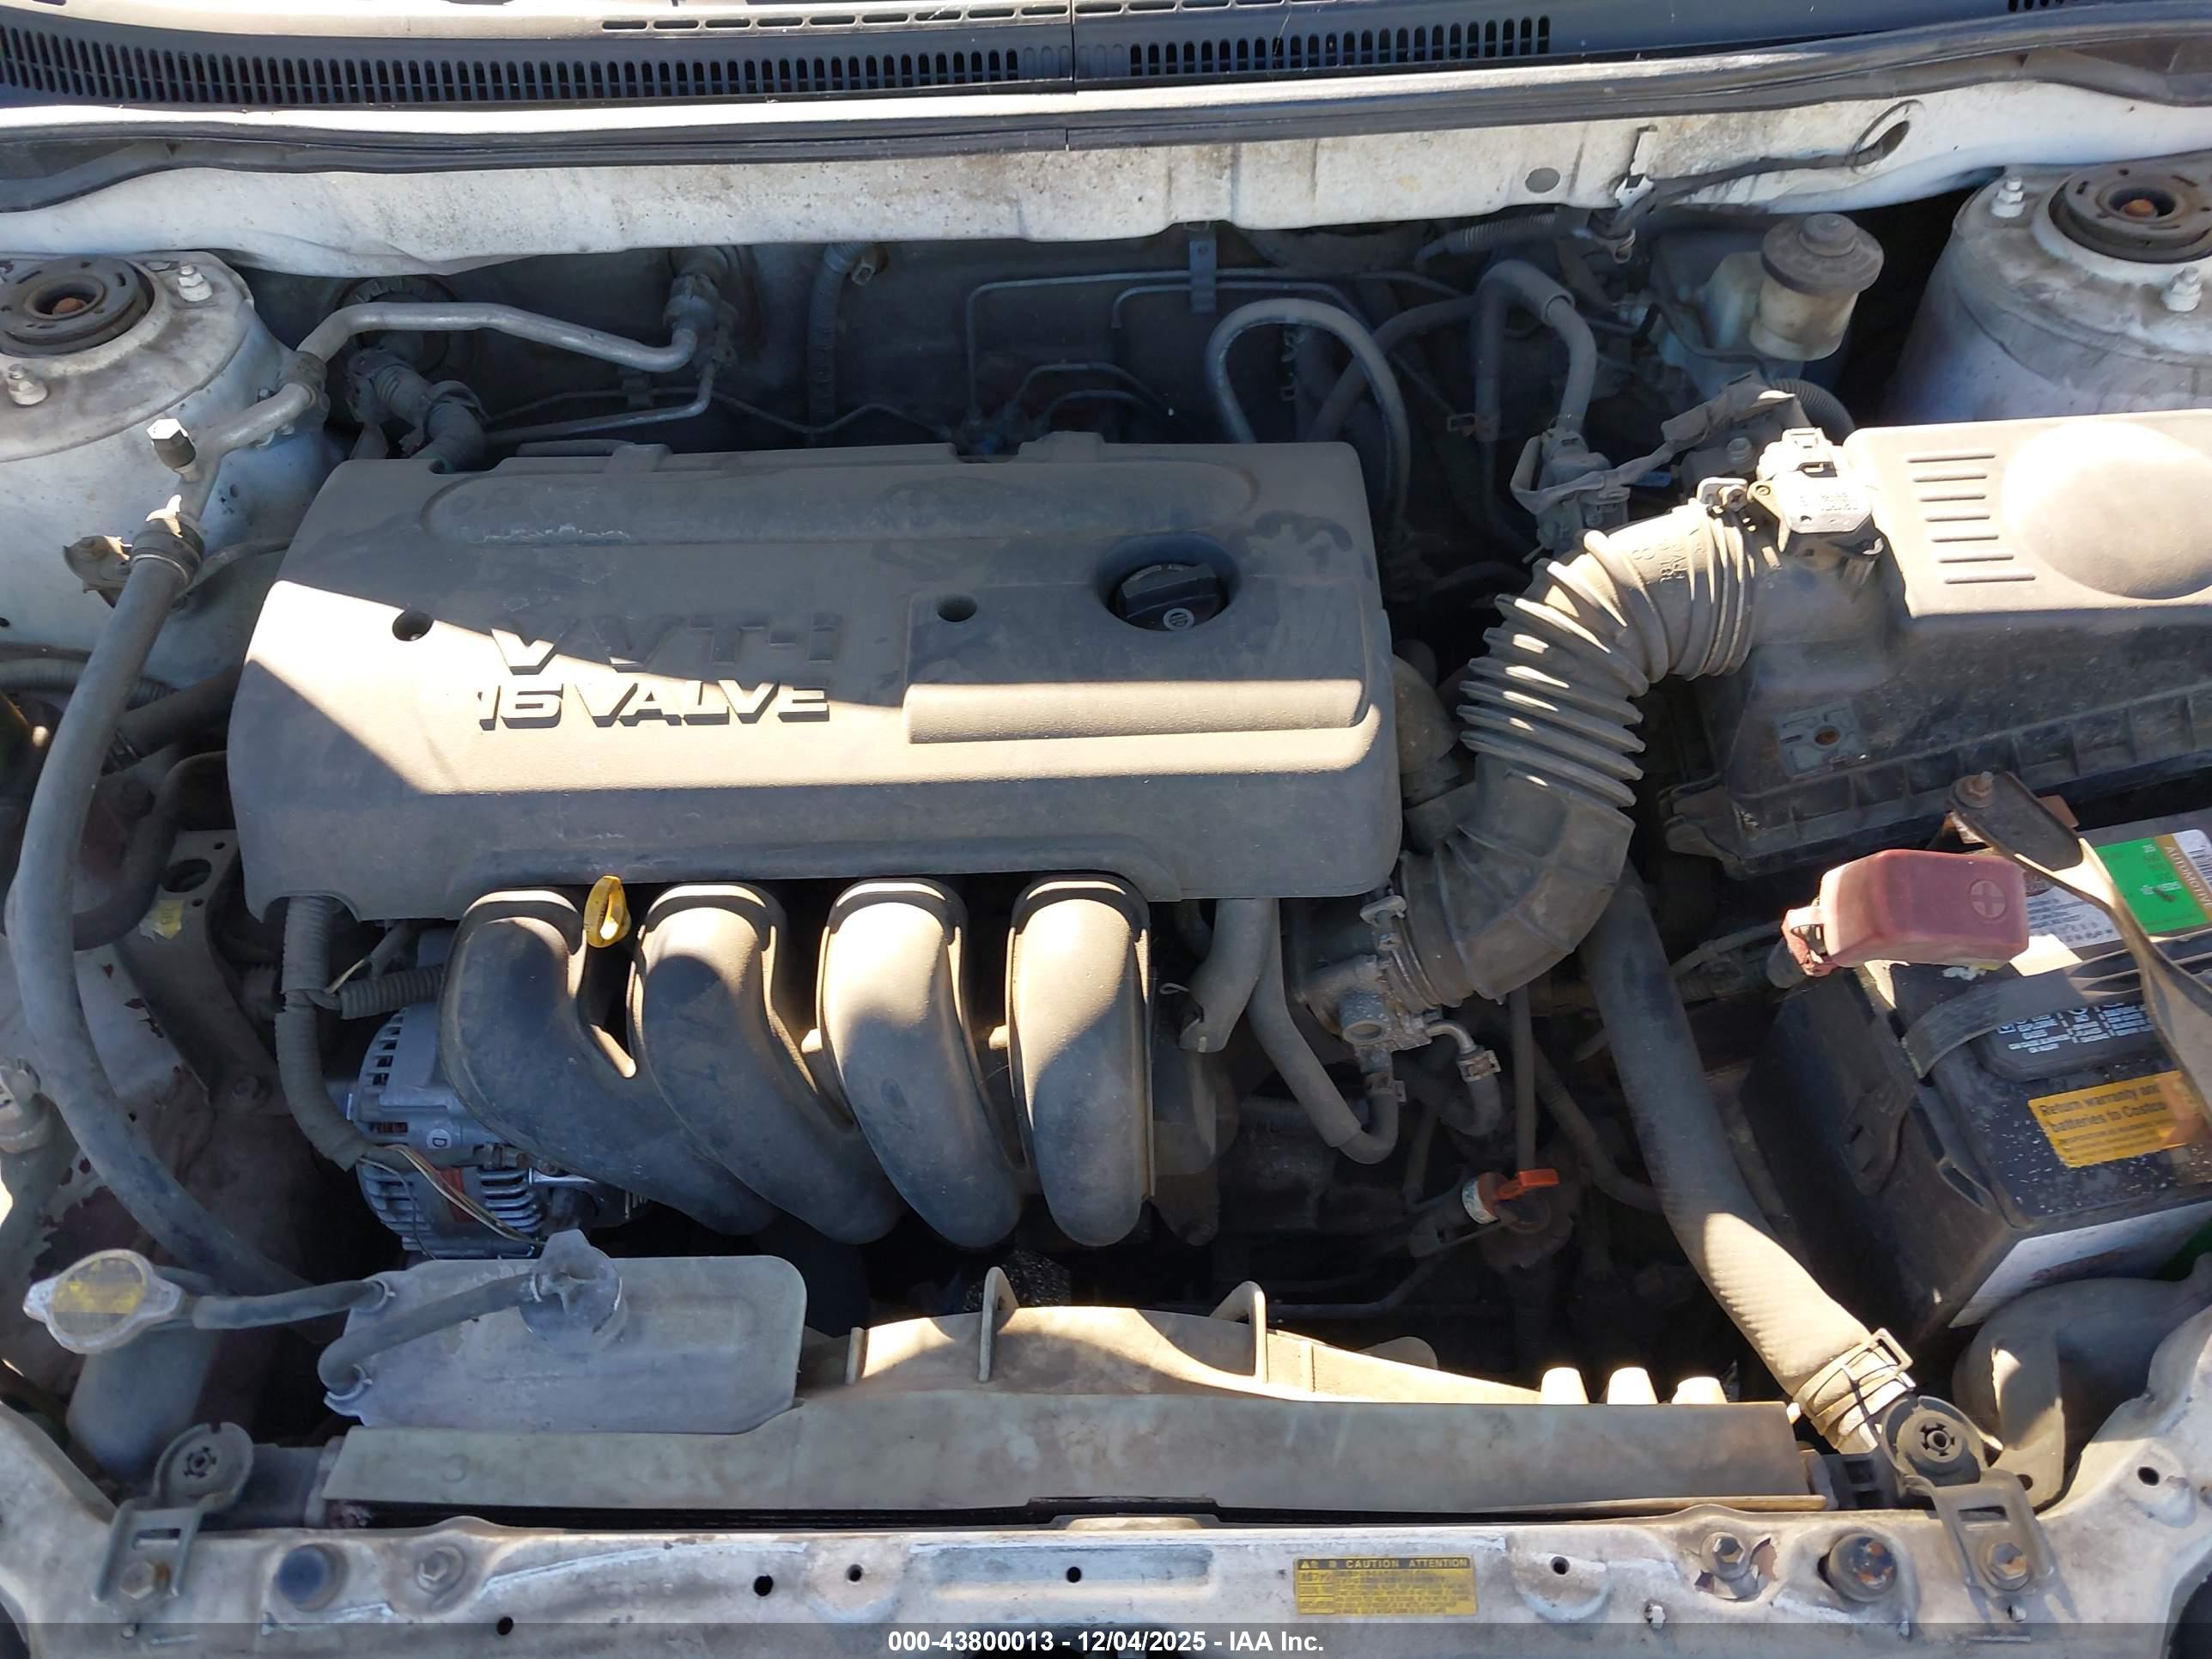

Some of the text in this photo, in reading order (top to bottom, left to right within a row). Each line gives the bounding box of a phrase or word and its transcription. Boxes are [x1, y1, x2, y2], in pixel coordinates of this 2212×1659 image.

[477, 678, 830, 731] 16 VALVE
[1345, 1559, 1400, 1569] CAUTION
[1408, 1558, 1468, 1568] ATTENTION
